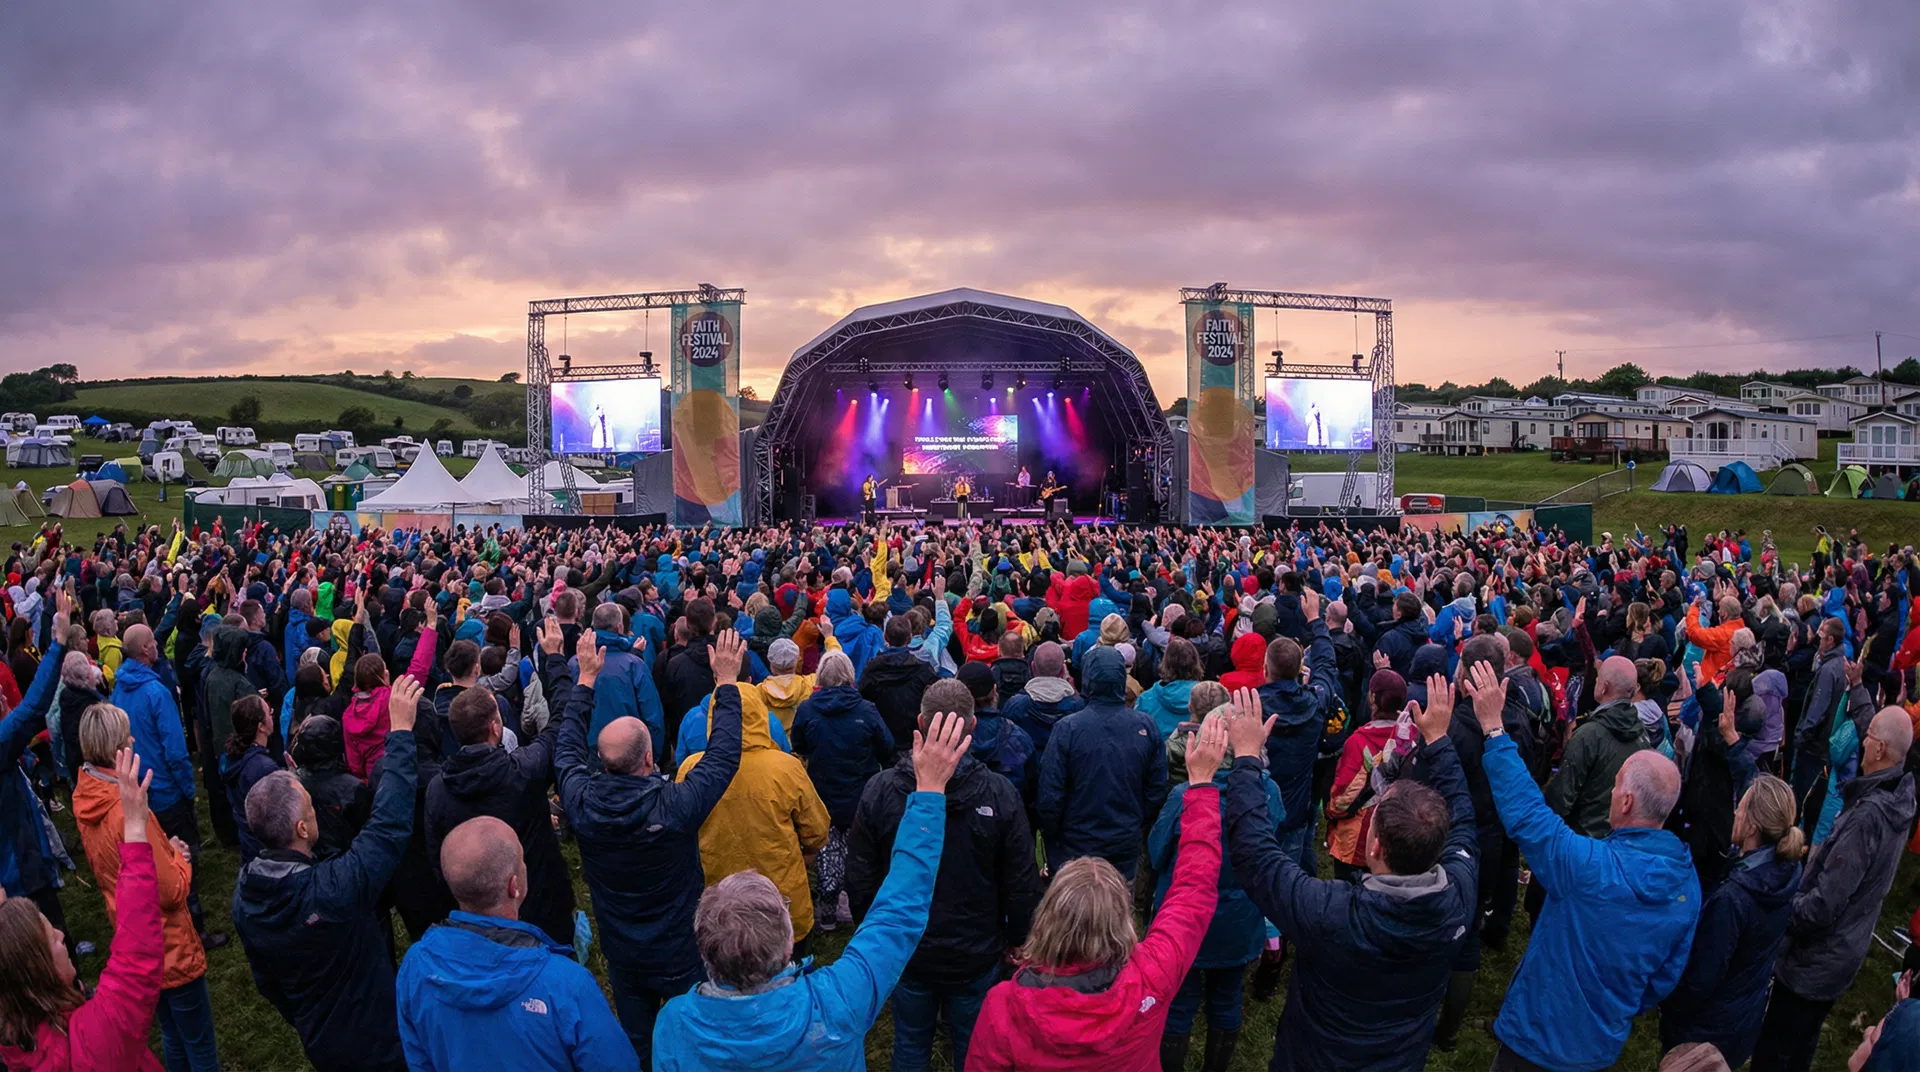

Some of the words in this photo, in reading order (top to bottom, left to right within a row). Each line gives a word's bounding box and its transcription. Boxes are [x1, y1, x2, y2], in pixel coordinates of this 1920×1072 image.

[691, 320, 720, 332] FAITH
[1206, 319, 1235, 331] FAITH
[682, 333, 730, 346] FESTIVAL
[1196, 332, 1244, 345] FESTIVAL
[692, 346, 719, 359] 2024
[1208, 345, 1234, 358] 2024
